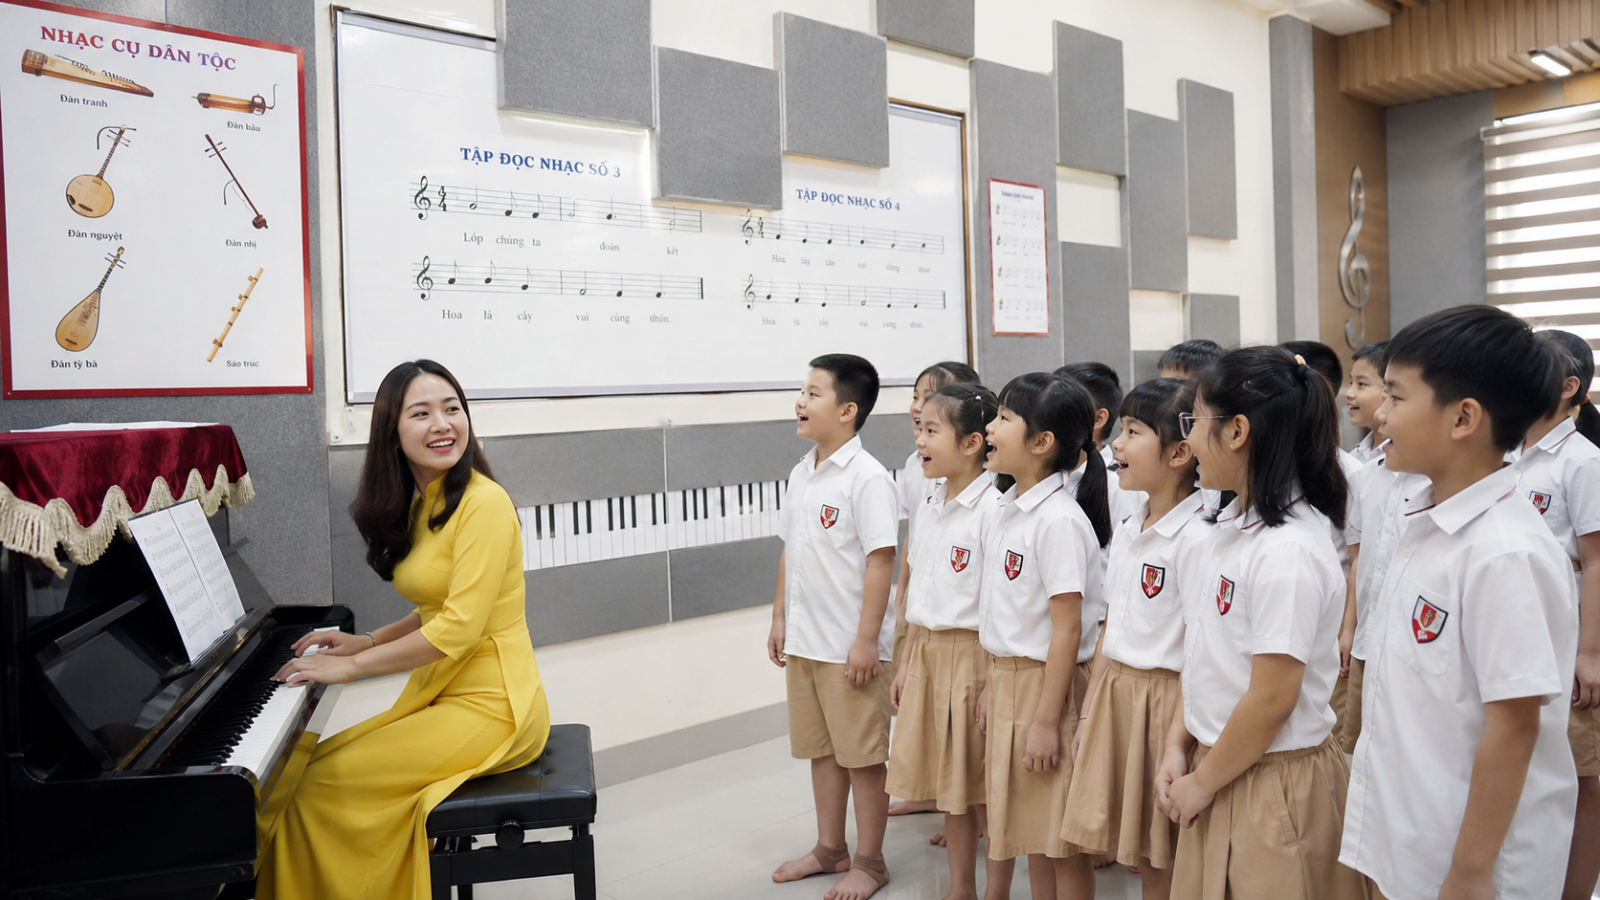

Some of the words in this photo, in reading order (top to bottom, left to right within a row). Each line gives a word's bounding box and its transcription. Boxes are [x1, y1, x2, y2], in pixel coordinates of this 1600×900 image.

[40, 26, 104, 50] NHẠC
[111, 38, 140, 58] CỤ
[148, 44, 191, 63] DÂN
[197, 52, 236, 71] TỘC
[82, 98, 108, 108] tranh
[460, 146, 494, 165] TẬP
[499, 152, 535, 170] ĐỌC
[540, 157, 584, 176] NHẠC
[588, 160, 609, 177] SỐ
[613, 166, 621, 178] 3
[796, 188, 818, 203] TẬP
[821, 192, 844, 206] ĐỌC
[847, 195, 877, 210] NHẠC
[879, 196, 893, 210] SỐ
[895, 202, 901, 211] 4
[532, 238, 542, 247] ta
[771, 254, 786, 264] Hoa
[441, 309, 463, 320] Hoa
[575, 312, 590, 322] vui
[762, 316, 776, 326] Hoa
